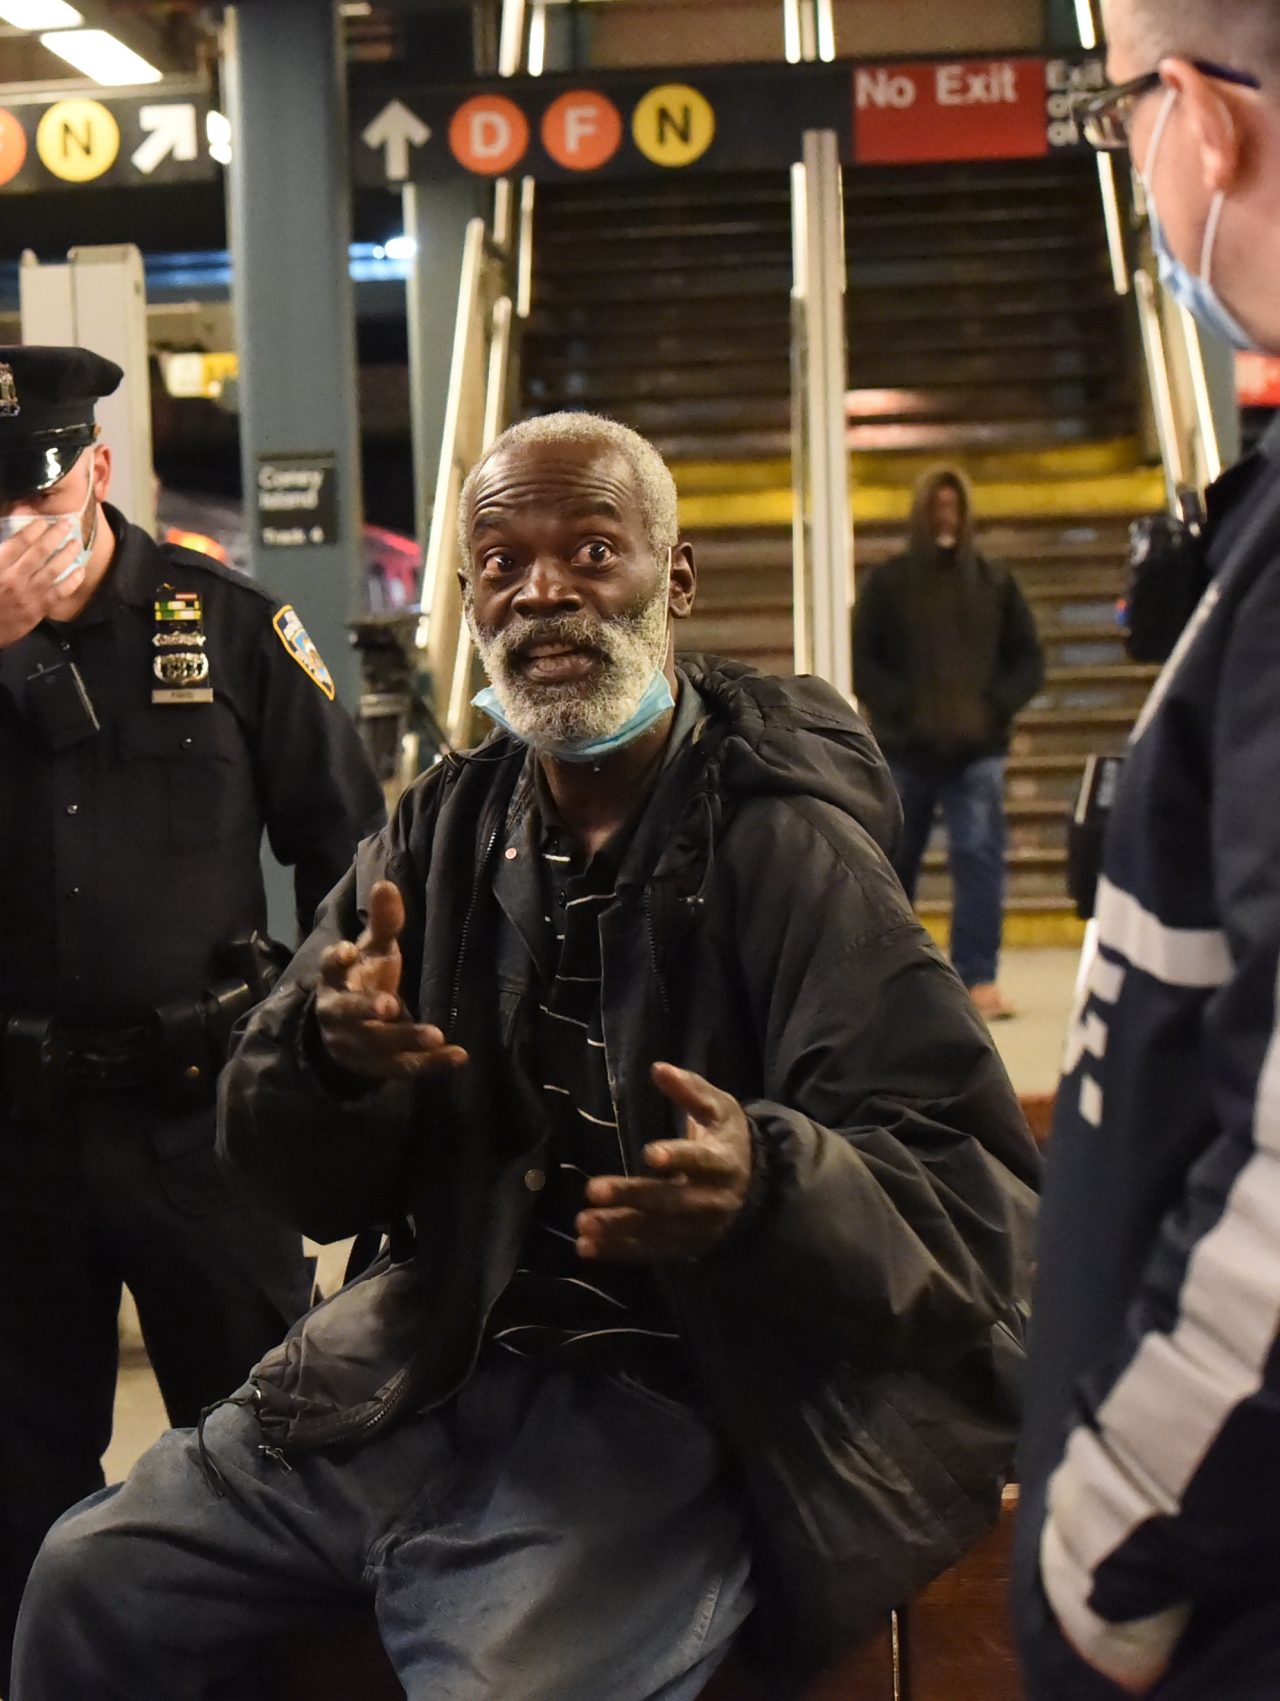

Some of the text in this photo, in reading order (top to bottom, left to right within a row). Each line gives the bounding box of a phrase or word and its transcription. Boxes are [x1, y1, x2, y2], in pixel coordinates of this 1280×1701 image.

[854, 68, 917, 109] No
[935, 62, 1019, 107] Exit
[61, 118, 92, 158] N
[472, 104, 692, 157] D F N
